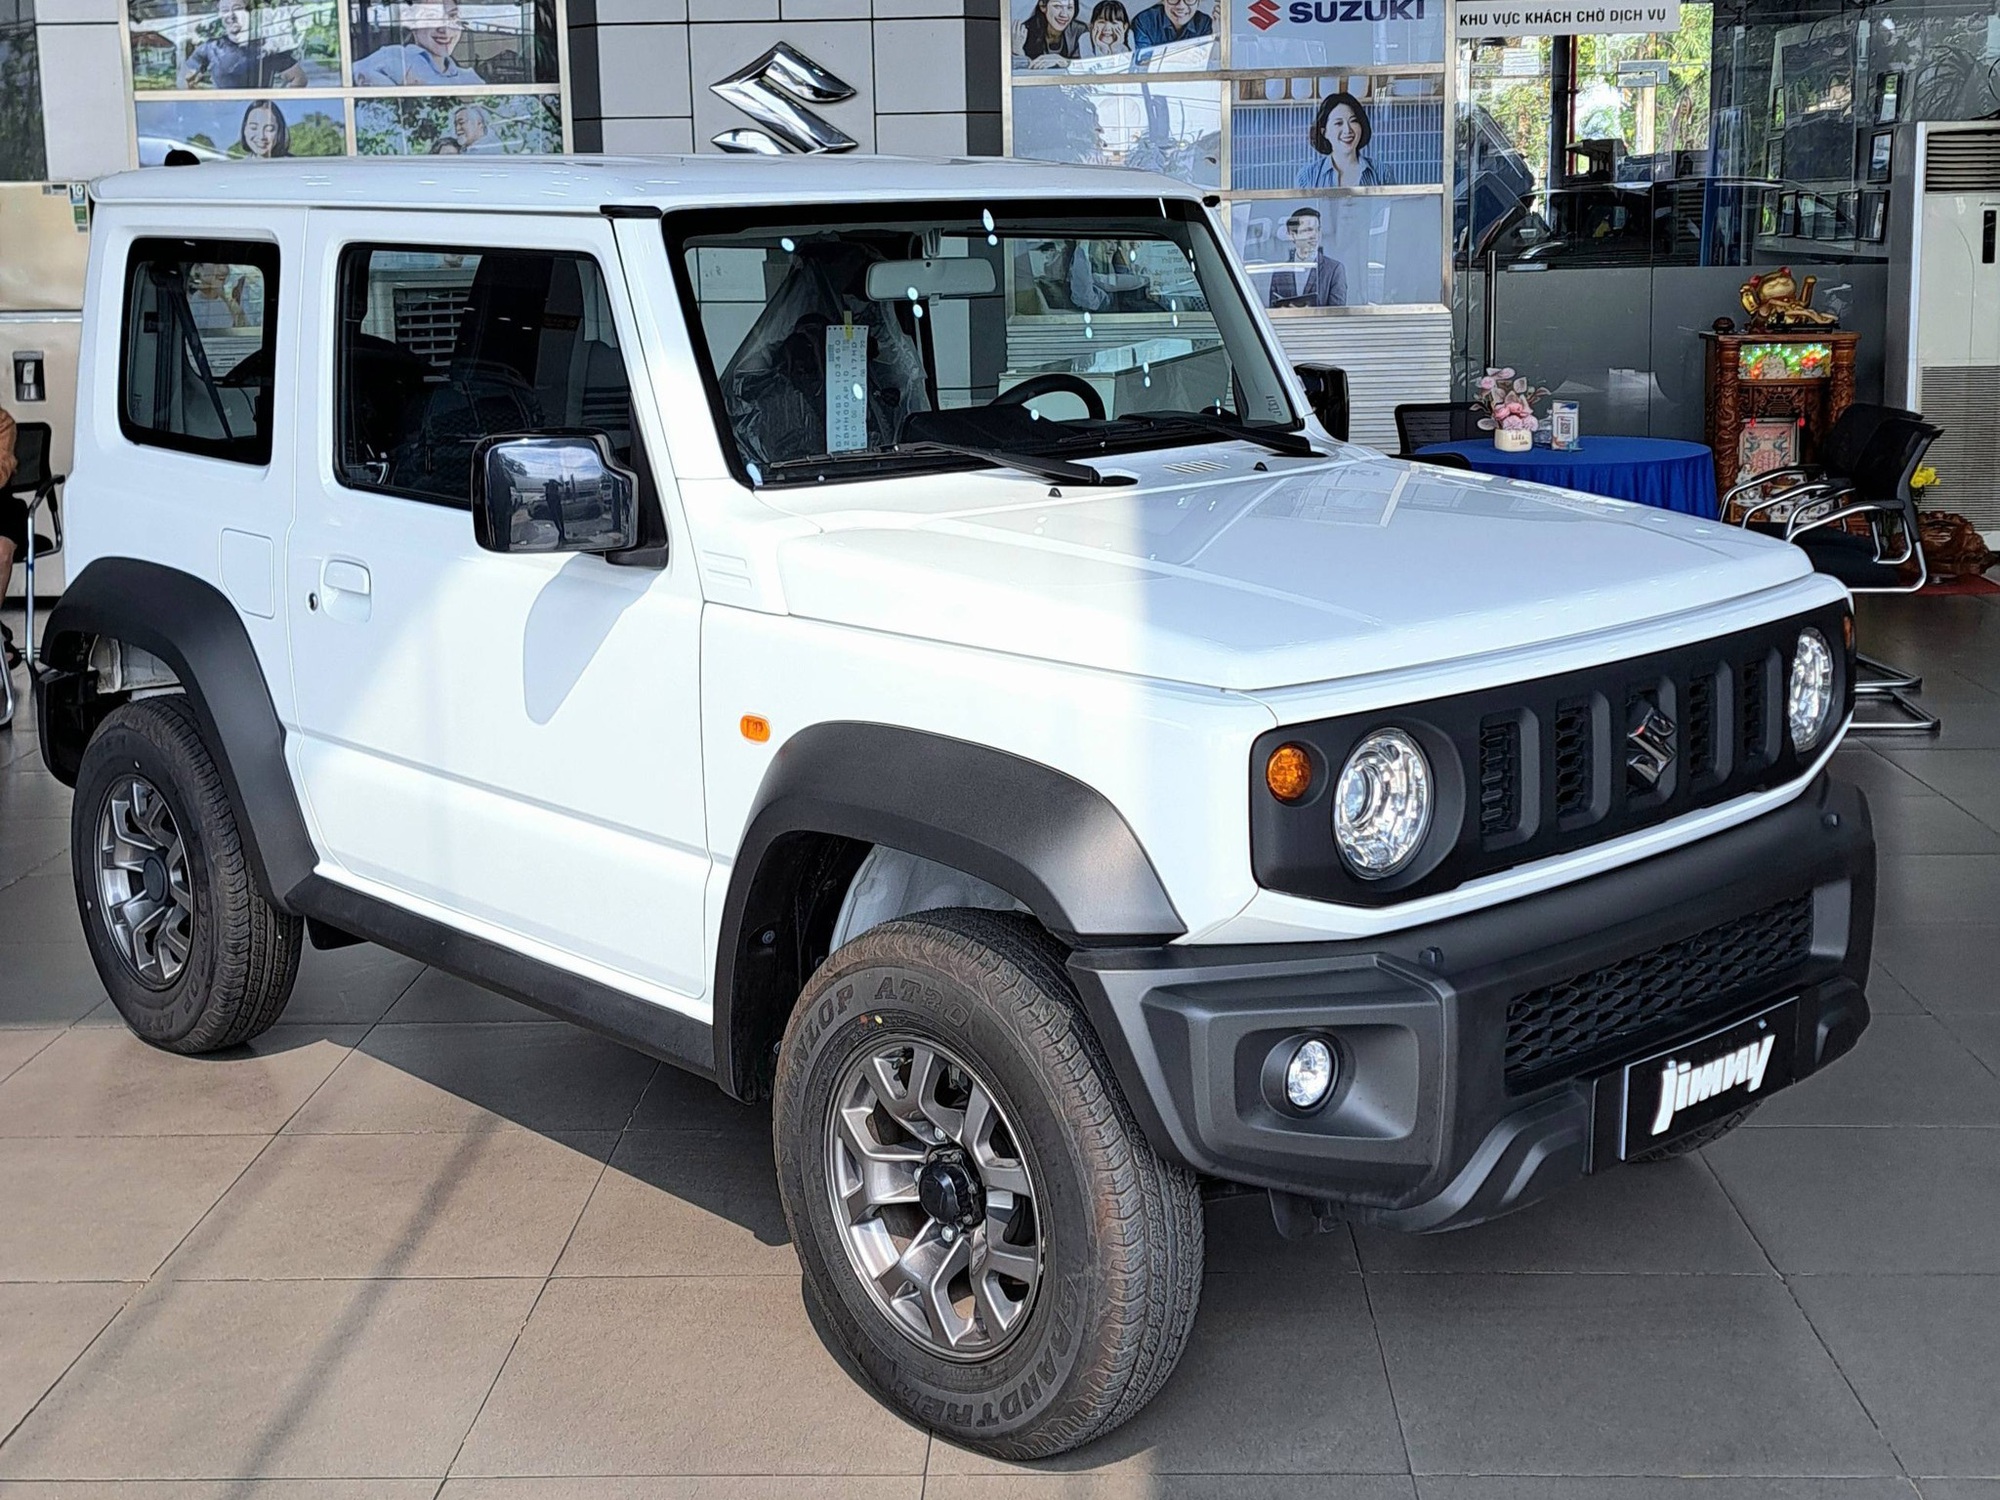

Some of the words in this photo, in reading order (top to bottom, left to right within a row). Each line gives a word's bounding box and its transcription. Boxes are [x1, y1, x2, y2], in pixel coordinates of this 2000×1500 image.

[1288, 0, 1425, 23] SUZUKI
[1460, 13, 1488, 26] KHU
[1493, 12, 1520, 30] VỰC
[1525, 9, 1572, 24] KHÁCH
[1576, 8, 1605, 23] CHỜ
[1610, 9, 1643, 25] DỊCH
[1647, 8, 1667, 24] VỤ
